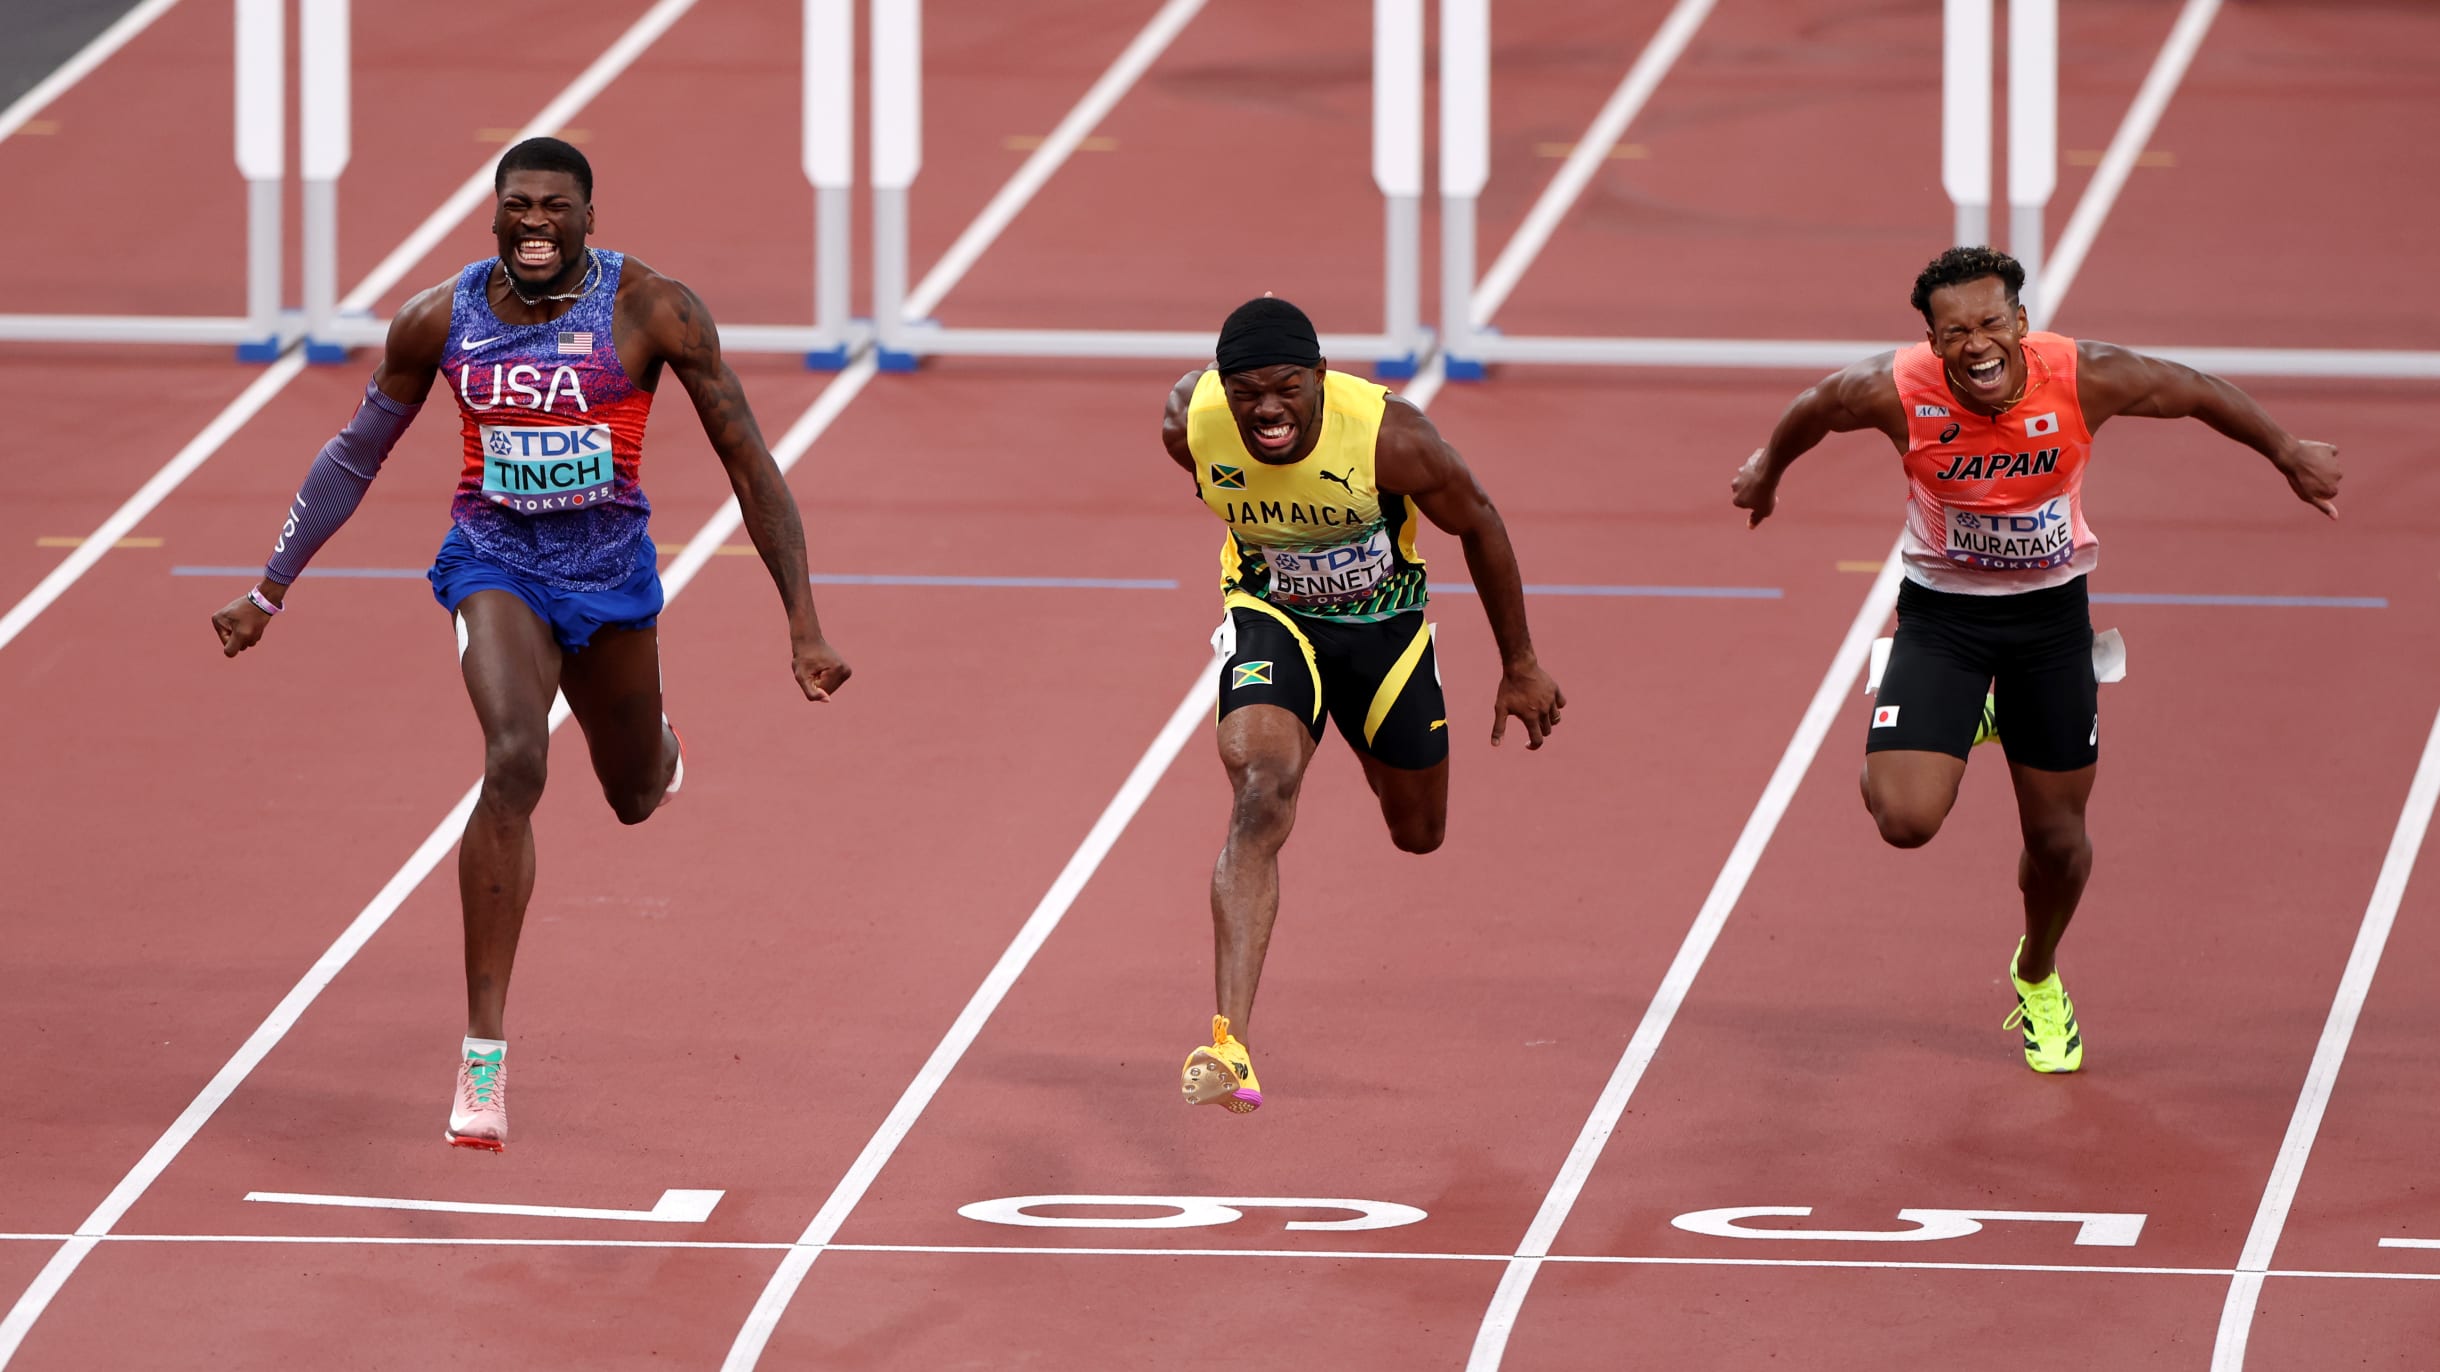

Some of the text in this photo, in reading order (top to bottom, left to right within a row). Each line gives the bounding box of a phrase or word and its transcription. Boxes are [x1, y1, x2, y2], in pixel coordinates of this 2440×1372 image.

[461, 364, 588, 413] USA
[1918, 407, 1946, 416] ACN
[511, 429, 600, 456] TDK
[494, 456, 601, 490] TINCH
[1937, 448, 2060, 481] JAPAN
[1225, 501, 1363, 526] JAMAICA
[1980, 500, 2063, 532] TDK
[1298, 537, 1384, 571] TDK
[1953, 523, 2067, 556] MURATAKE
[1277, 553, 1387, 595] BENNETT
[244, 1189, 726, 1222] 7
[956, 1193, 1428, 1231] 6
[1671, 1206, 2147, 1246] 5
